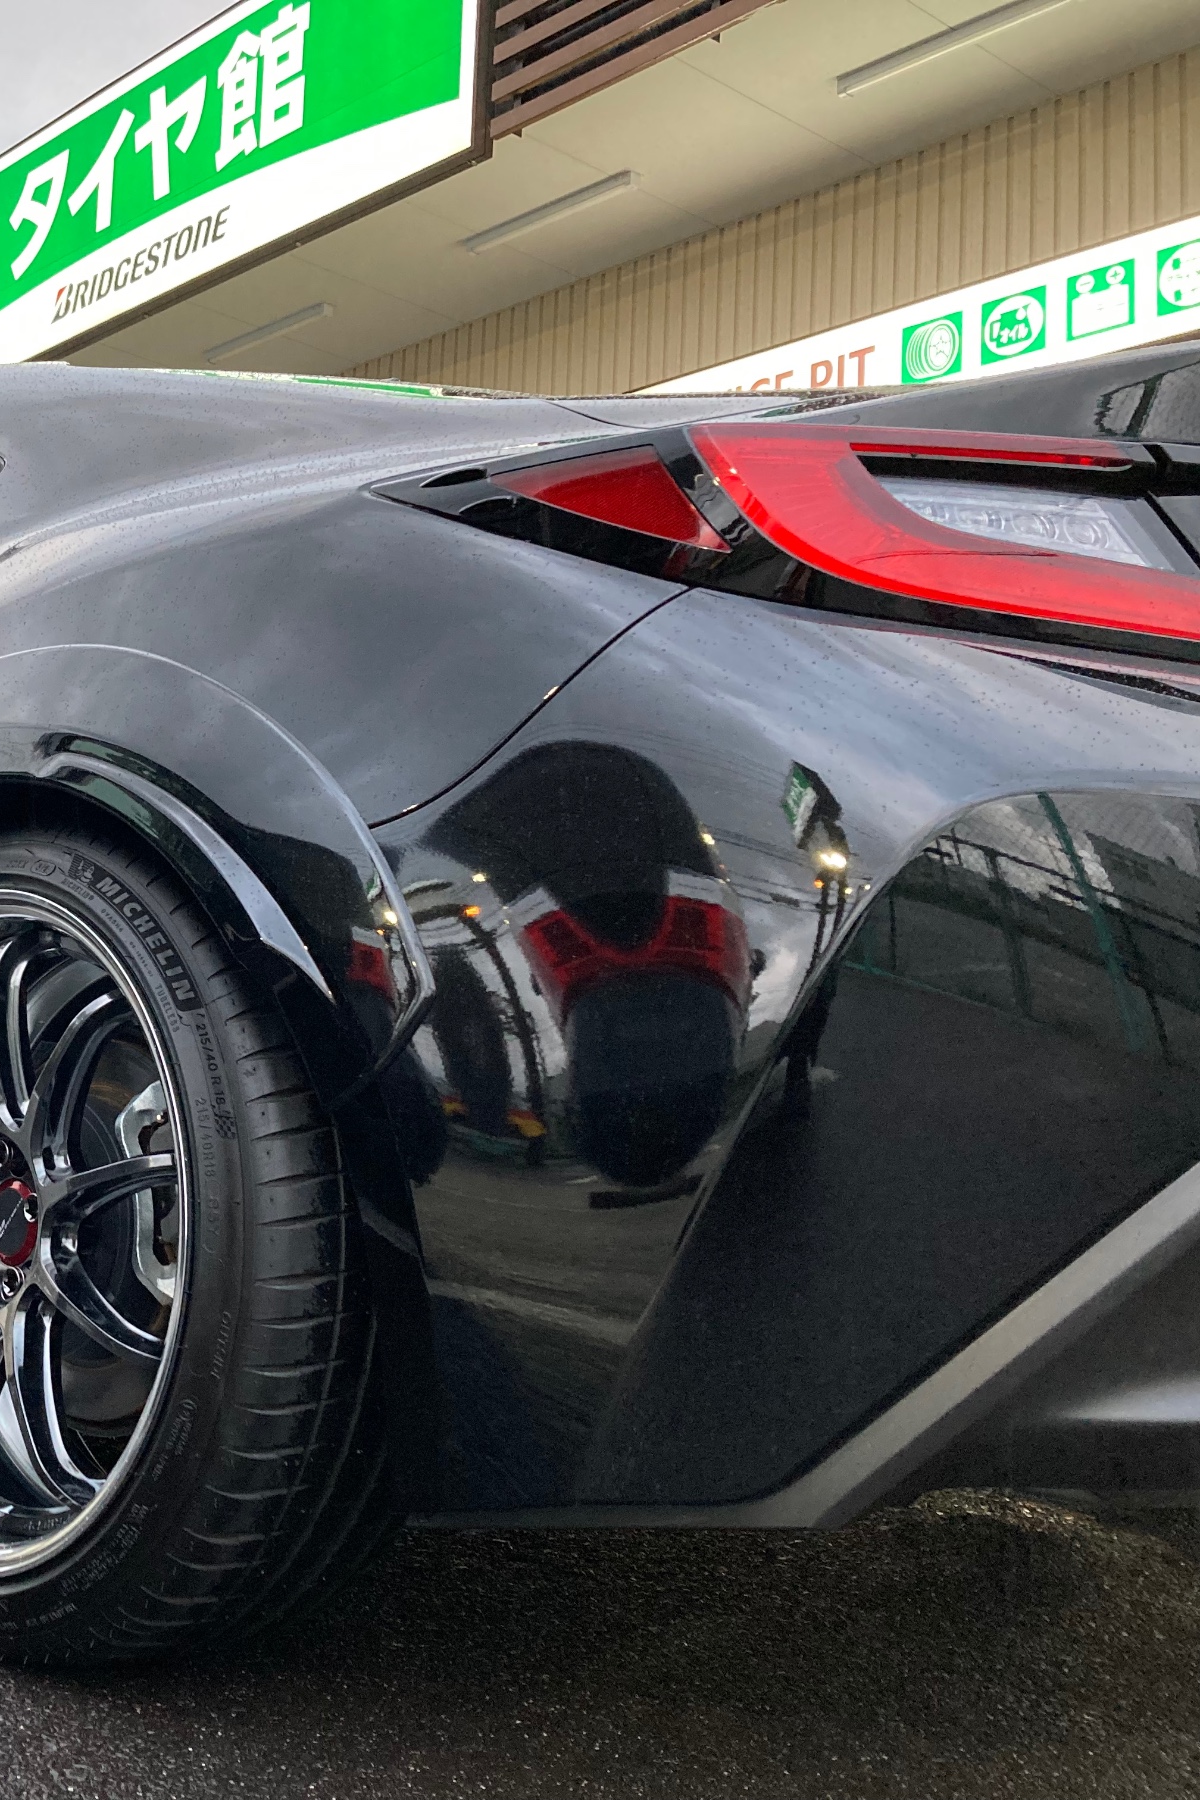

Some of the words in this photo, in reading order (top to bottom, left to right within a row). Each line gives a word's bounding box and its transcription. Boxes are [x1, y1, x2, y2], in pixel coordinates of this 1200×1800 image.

[9, 2, 310, 280] タイヤ館
[51, 205, 231, 324] BRIDGESTONE
[810, 345, 876, 389] PIT
[96, 877, 196, 1002] MICHELIN
[210, 1076, 222, 1086] R
